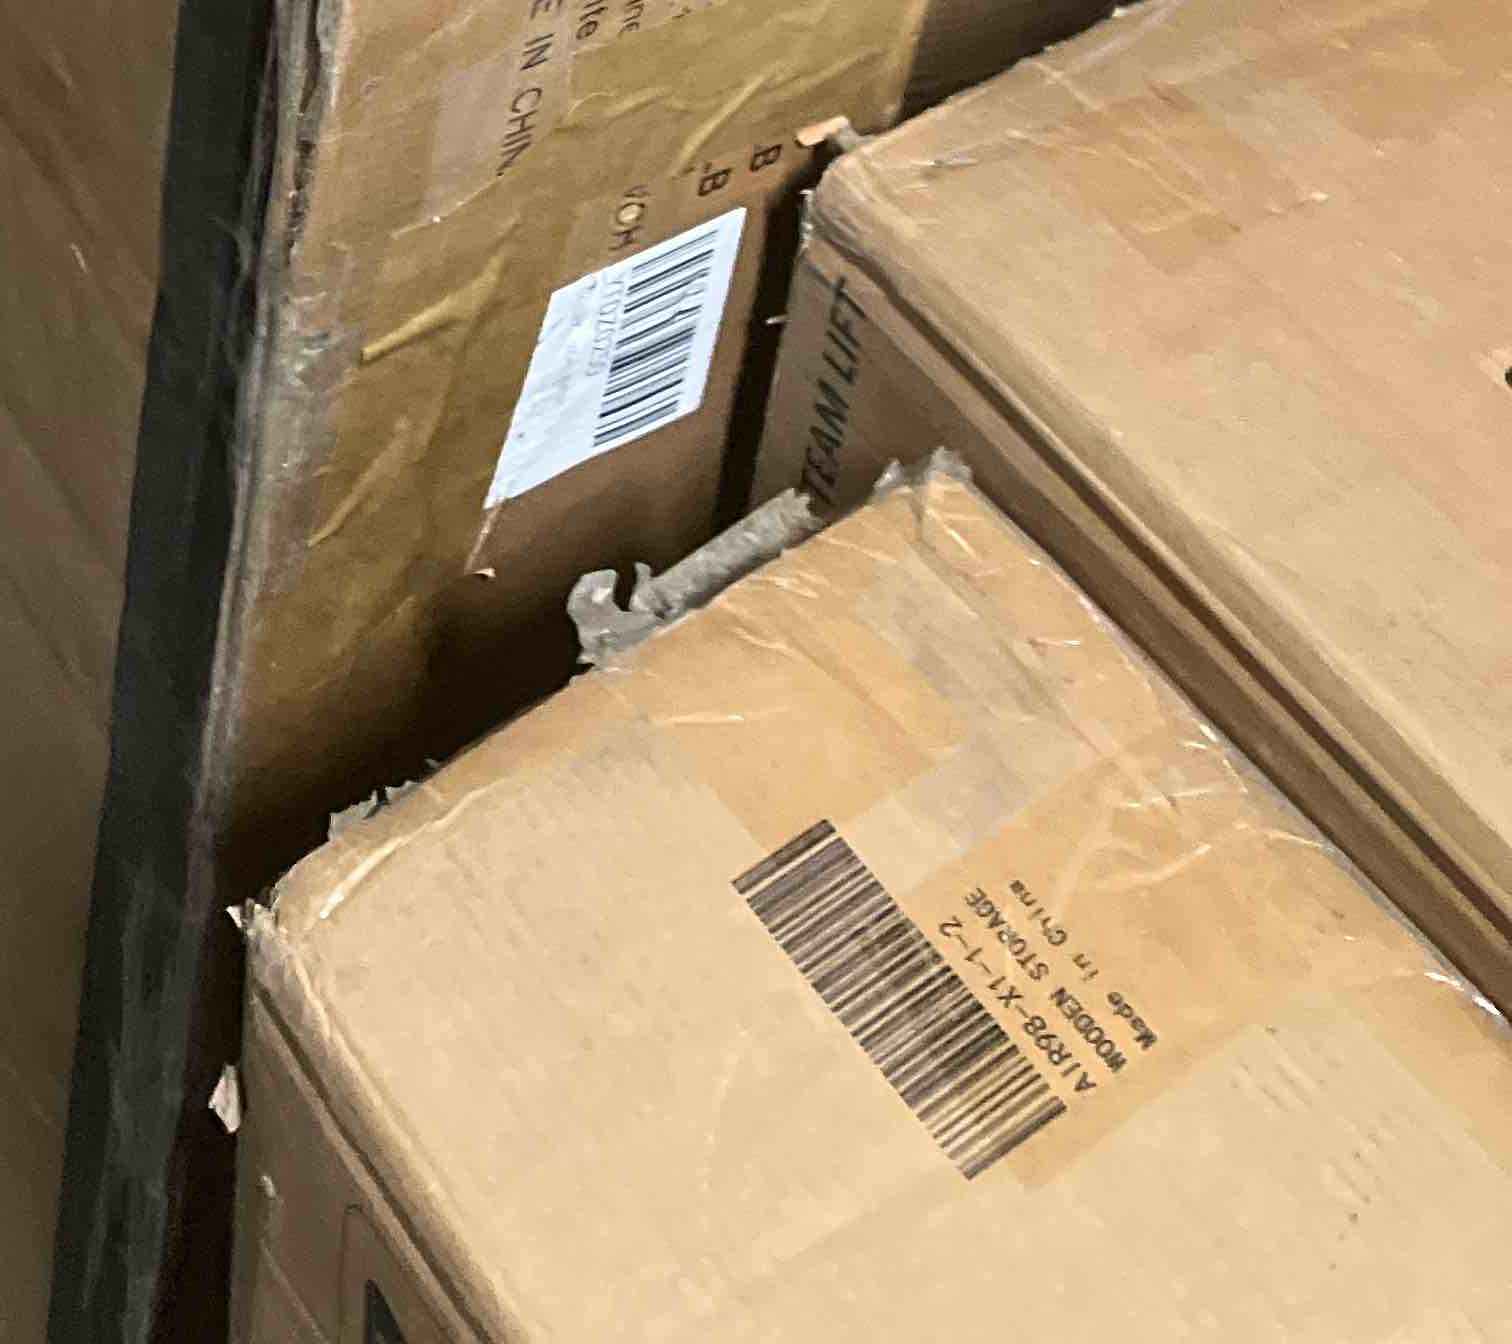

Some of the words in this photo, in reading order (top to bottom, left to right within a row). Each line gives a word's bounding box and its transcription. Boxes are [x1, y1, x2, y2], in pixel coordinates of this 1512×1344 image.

[519, 31, 555, 72] IN
[821, 274, 868, 386] LIFT
[800, 376, 851, 515] TEAM
[964, 886, 1050, 982] STORAGE
[1009, 879, 1068, 947] China
[938, 914, 1098, 1094] AIR98-X1-1-2
[1072, 952, 1100, 983] in
[1049, 986, 1128, 1074] WOODEN
[1106, 991, 1159, 1051] Made
